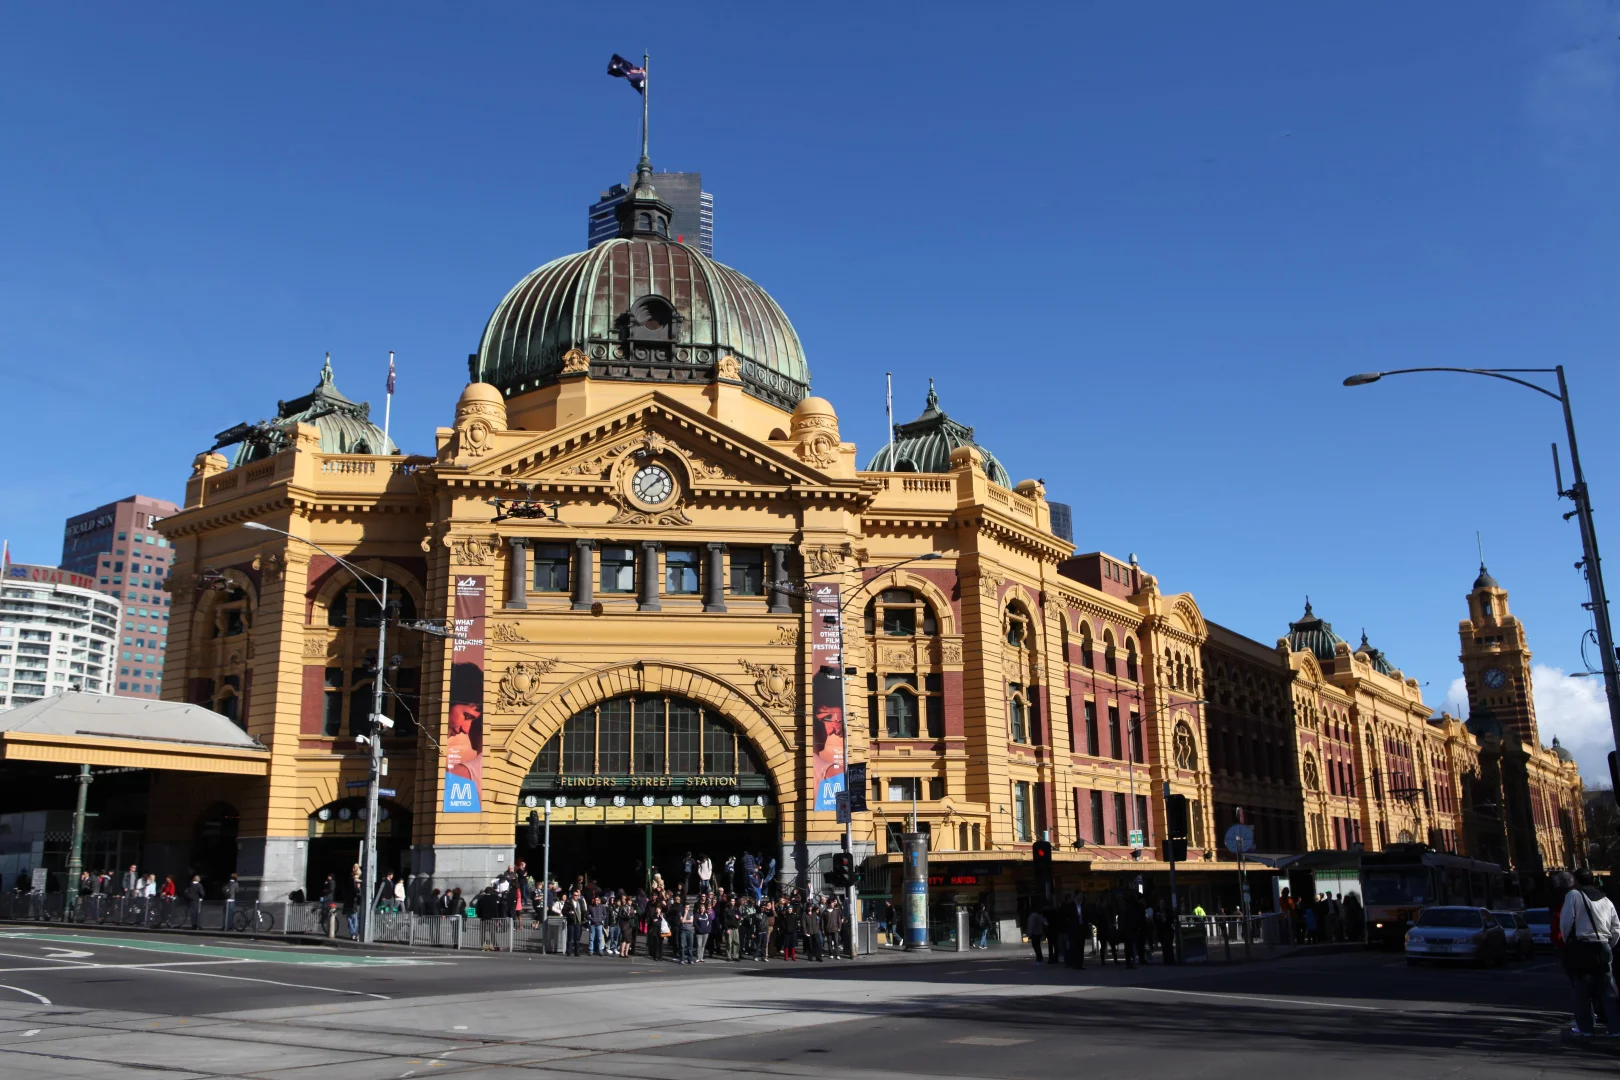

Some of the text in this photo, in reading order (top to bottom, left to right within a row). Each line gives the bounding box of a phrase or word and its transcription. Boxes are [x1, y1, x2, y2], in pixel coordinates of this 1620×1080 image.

[96, 514, 113, 528] SUN
[32, 568, 94, 589] QUAY WEST
[560, 776, 738, 787] FLINDERS STREET STATION
[928, 876, 944, 884] ITY
